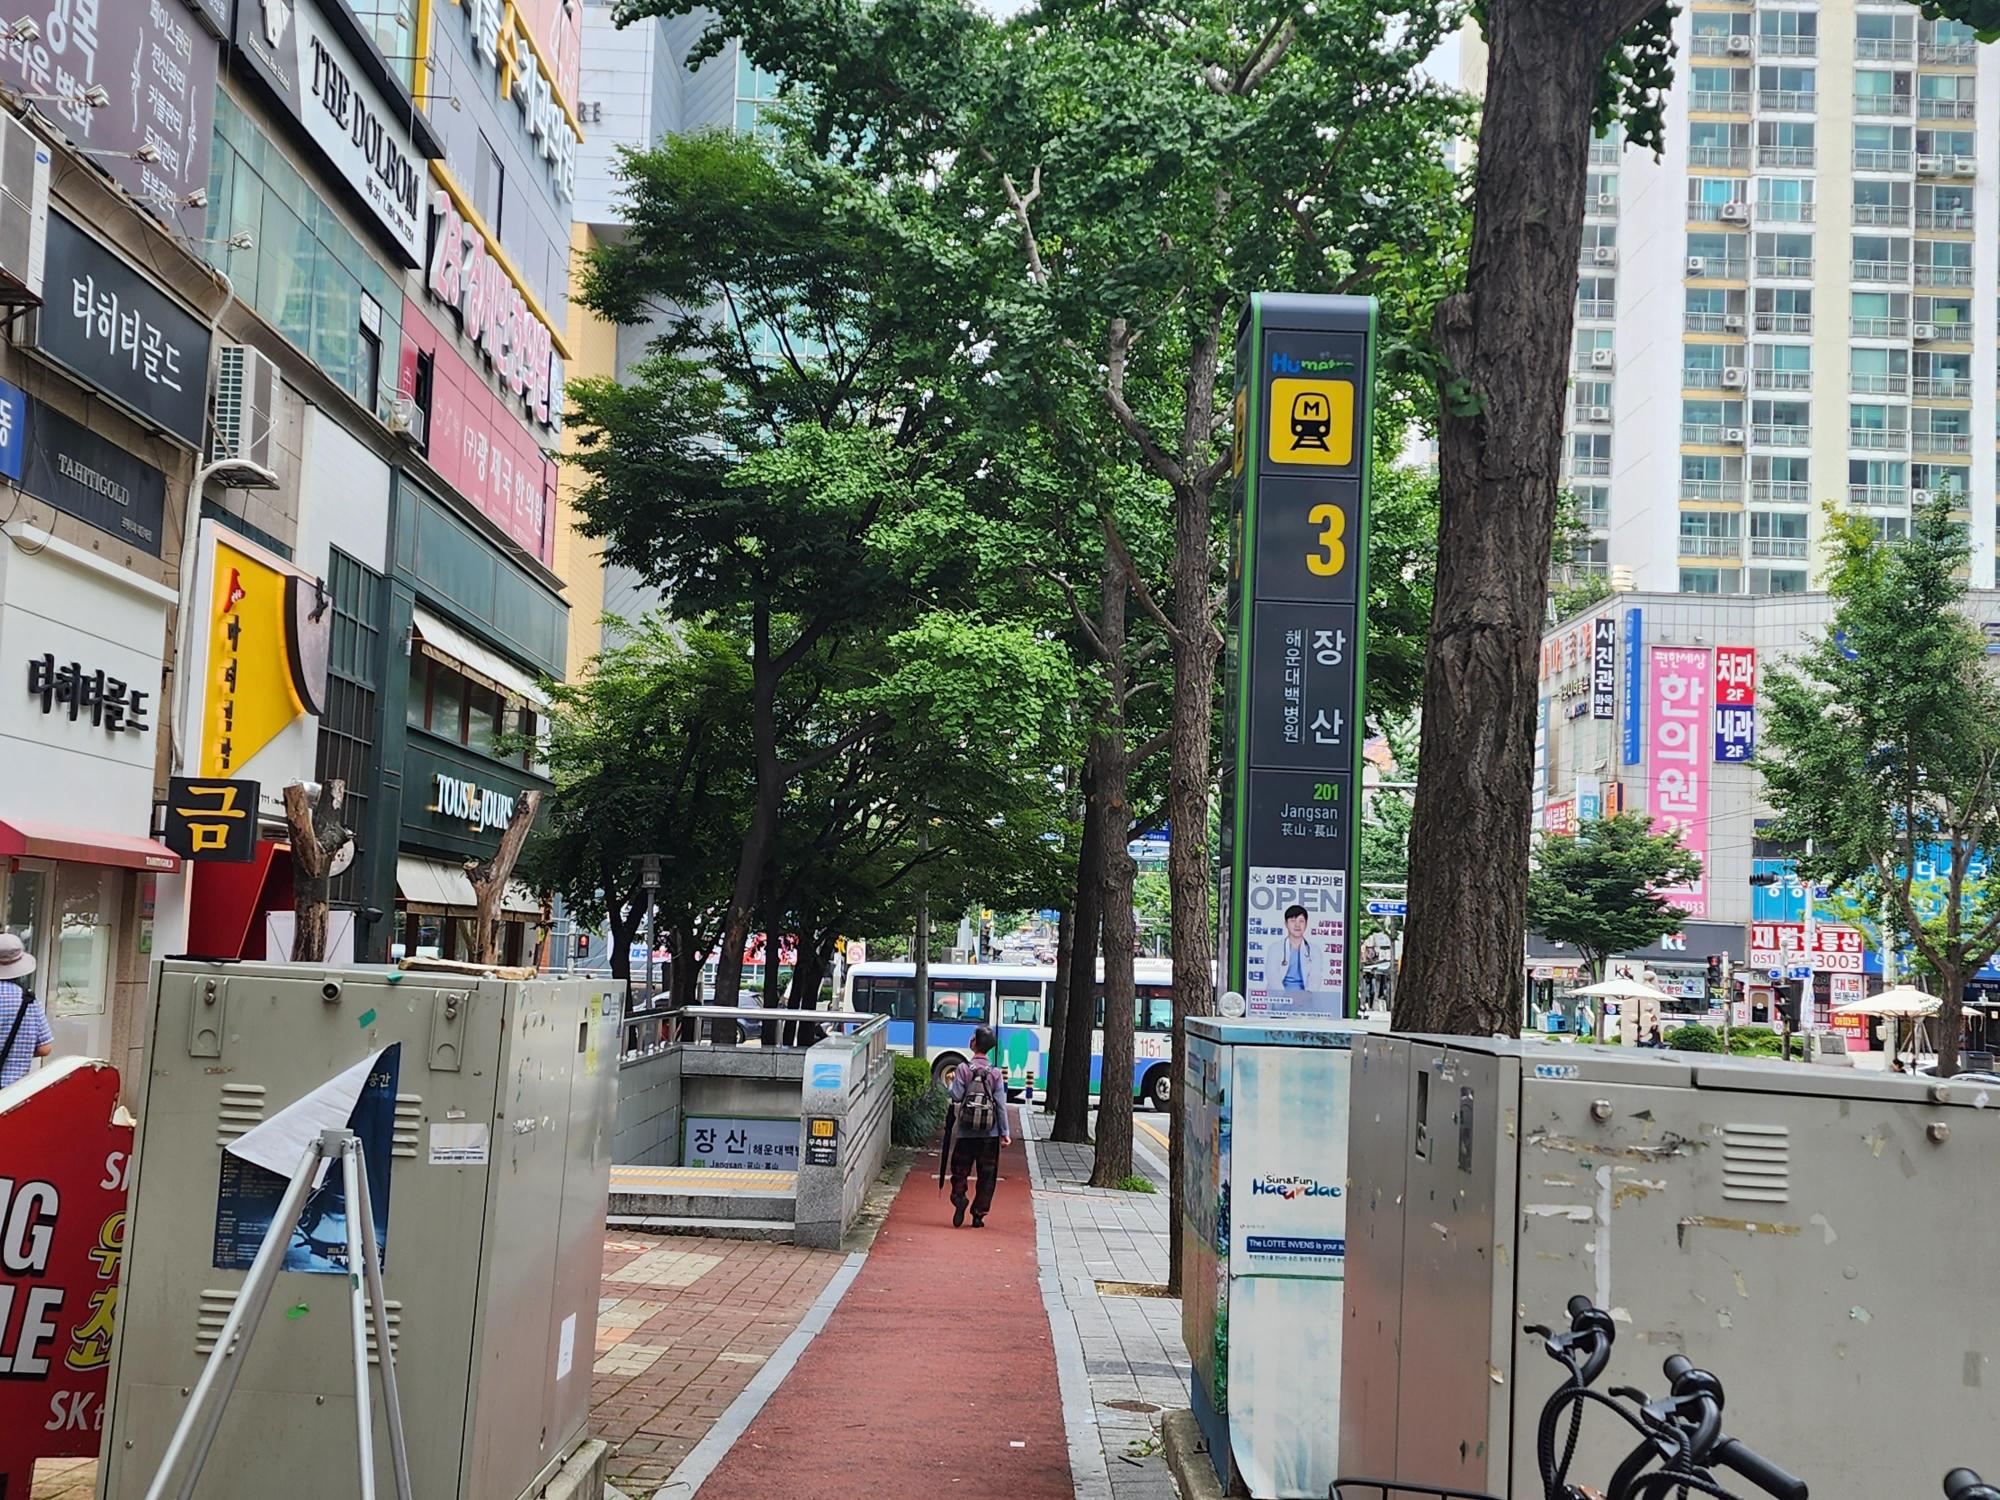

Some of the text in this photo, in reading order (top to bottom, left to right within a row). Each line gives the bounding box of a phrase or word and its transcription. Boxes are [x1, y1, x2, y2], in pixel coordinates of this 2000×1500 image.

[151, 42, 186, 100] 전신관리
[148, 84, 182, 140] 커플관리
[310, 34, 350, 131] THE
[351, 86, 421, 222] DOLBOM
[72, 274, 182, 392] 타히티골드
[58, 453, 130, 506] TAHITIGOLD
[1306, 503, 1346, 577] 3
[1596, 622, 1615, 692] 사진관
[1655, 651, 1706, 669] 편한세상
[1717, 652, 1753, 688] 치과
[28, 653, 149, 733] 타히티골드
[1283, 630, 1302, 743] 해운대백병원
[1310, 629, 1346, 745] 장산
[1726, 688, 1745, 701] 2F
[1657, 673, 1704, 813] 한의원
[1717, 709, 1753, 744] 내과
[1725, 745, 1744, 758] 2F
[436, 773, 469, 820] TOUS
[1313, 783, 1339, 801] 201
[176, 786, 246, 853] 금
[1280, 803, 1338, 822] Jangsan
[1300, 874, 1344, 887] 내과의원
[1250, 886, 1343, 913] OPEN
[1661, 932, 1688, 951] kt
[1834, 991, 1860, 1001] 부동산
[1836, 979, 1860, 991] 재벌
[369, 1072, 392, 1088] 공간
[694, 1128, 748, 1155] 장산
[1265, 1174, 1313, 1186] Sun&Fun
[0, 1178, 59, 1275] G
[1249, 1239, 1262, 1248] The
[1262, 1239, 1287, 1249] LOTTE
[1287, 1240, 1315, 1250] INVENS
